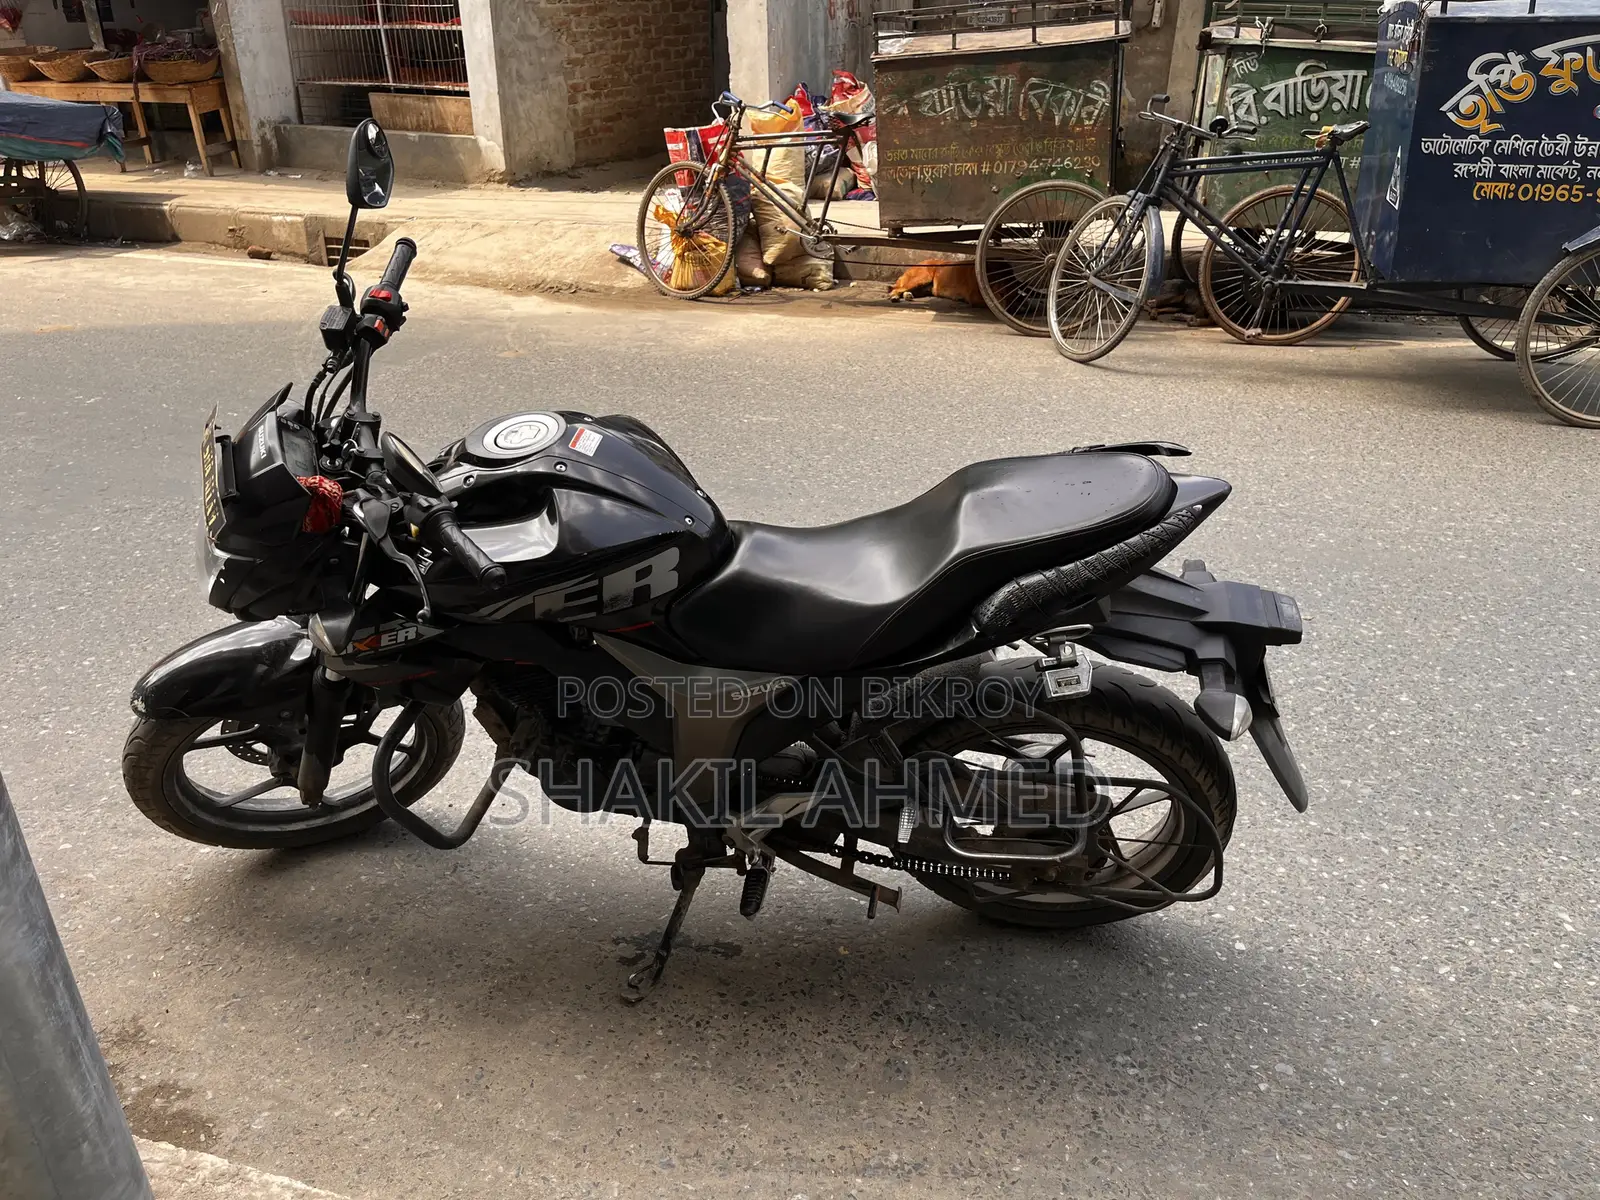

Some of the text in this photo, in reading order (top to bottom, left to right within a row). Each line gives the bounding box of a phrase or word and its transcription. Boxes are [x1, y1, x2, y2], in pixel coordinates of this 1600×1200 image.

[1420, 133, 1600, 158] অটোমেটিক মেশিনে তৈরী উন্ন
[1453, 156, 1496, 179] রূপসী
[1498, 164, 1534, 179] বাংলা
[1536, 160, 1582, 183] মার্কেট,
[258, 424, 267, 459] SUZUKI
[730, 679, 788, 702] SUZUKI
